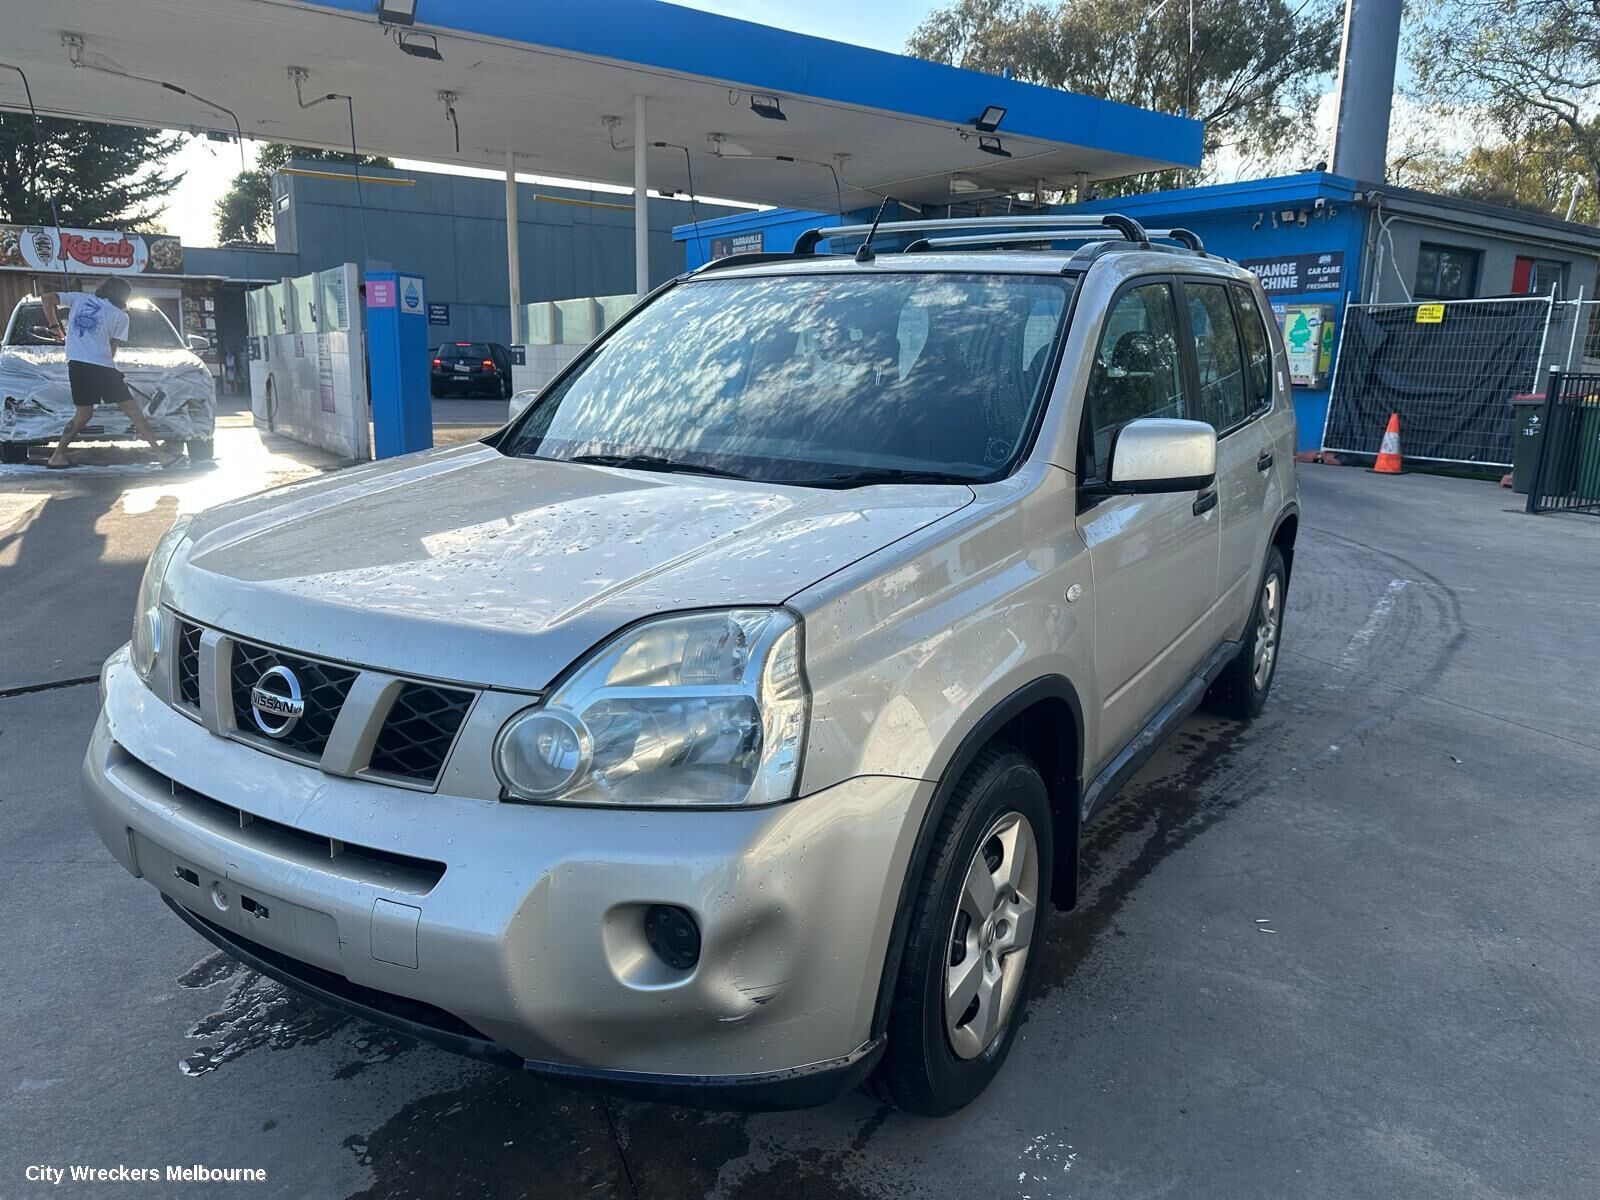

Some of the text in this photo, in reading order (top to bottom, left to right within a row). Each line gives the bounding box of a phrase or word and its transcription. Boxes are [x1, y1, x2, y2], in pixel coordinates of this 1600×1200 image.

[57, 233, 134, 261] Kebab
[92, 256, 129, 266] BREAK
[1307, 265, 1340, 275] CAR CARE
[1260, 275, 1298, 290] CHINE
[252, 690, 294, 714] NISSAN
